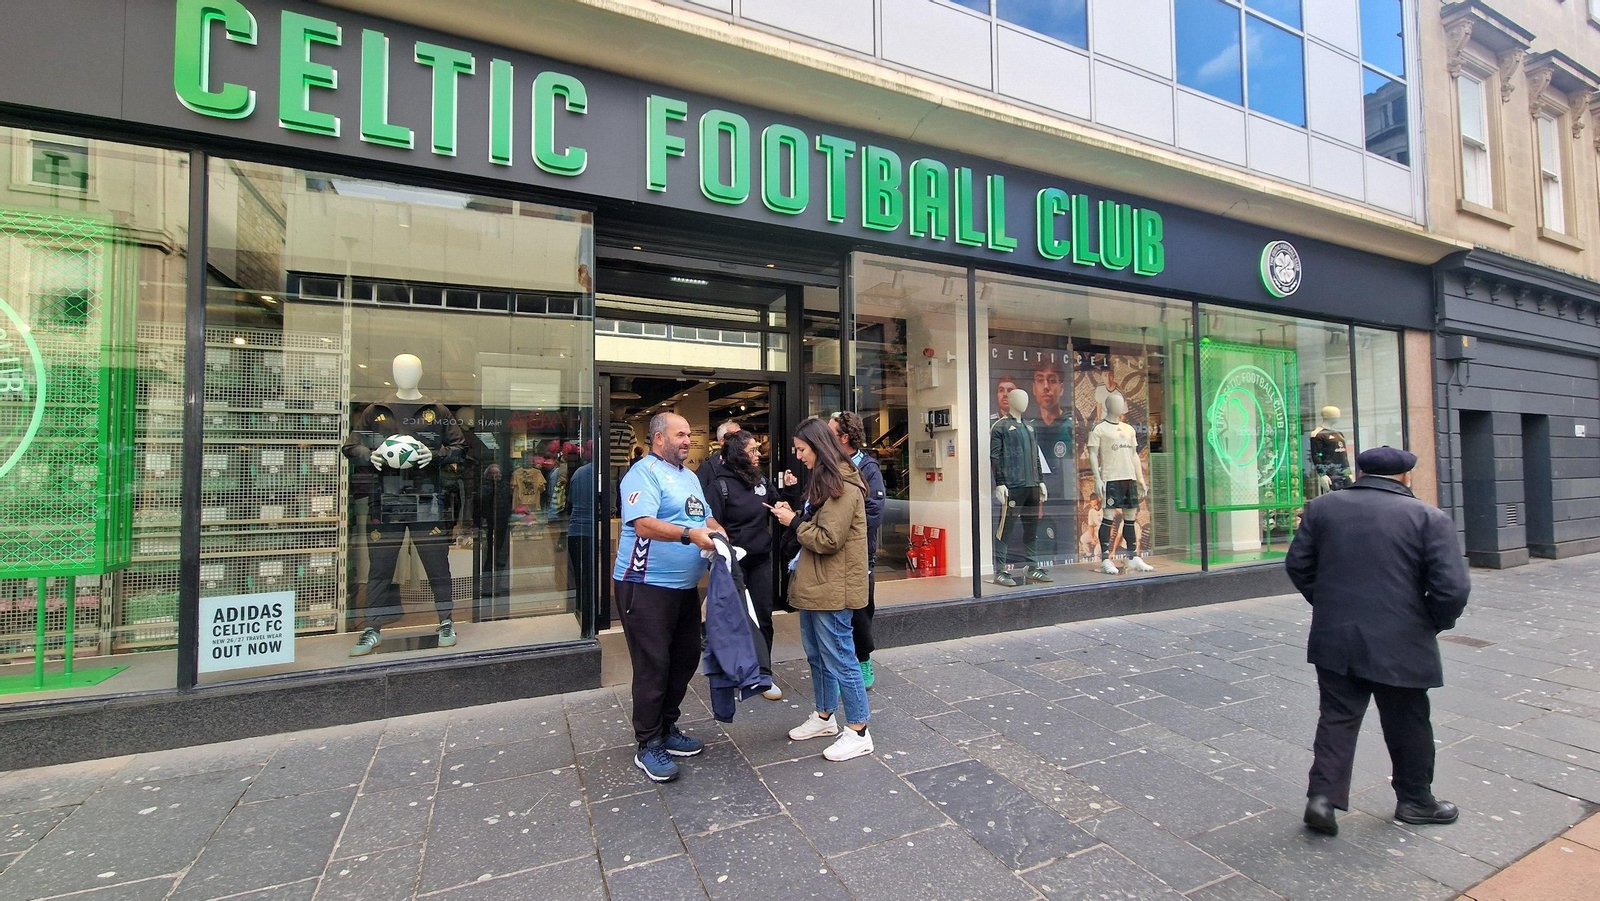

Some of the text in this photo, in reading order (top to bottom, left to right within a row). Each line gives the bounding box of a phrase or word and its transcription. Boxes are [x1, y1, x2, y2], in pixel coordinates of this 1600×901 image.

[174, 0, 1164, 276] CELTIC FOOTBALL CLUB
[992, 348, 1069, 364] CELTIC
[1077, 354, 1143, 370] CELTIC
[1242, 372, 1276, 401] FOOTBALL
[1274, 399, 1284, 428] CLUB
[213, 603, 282, 623] ADIDAS
[212, 620, 282, 637] CELTIC FC
[212, 640, 282, 659] OUT NOW
